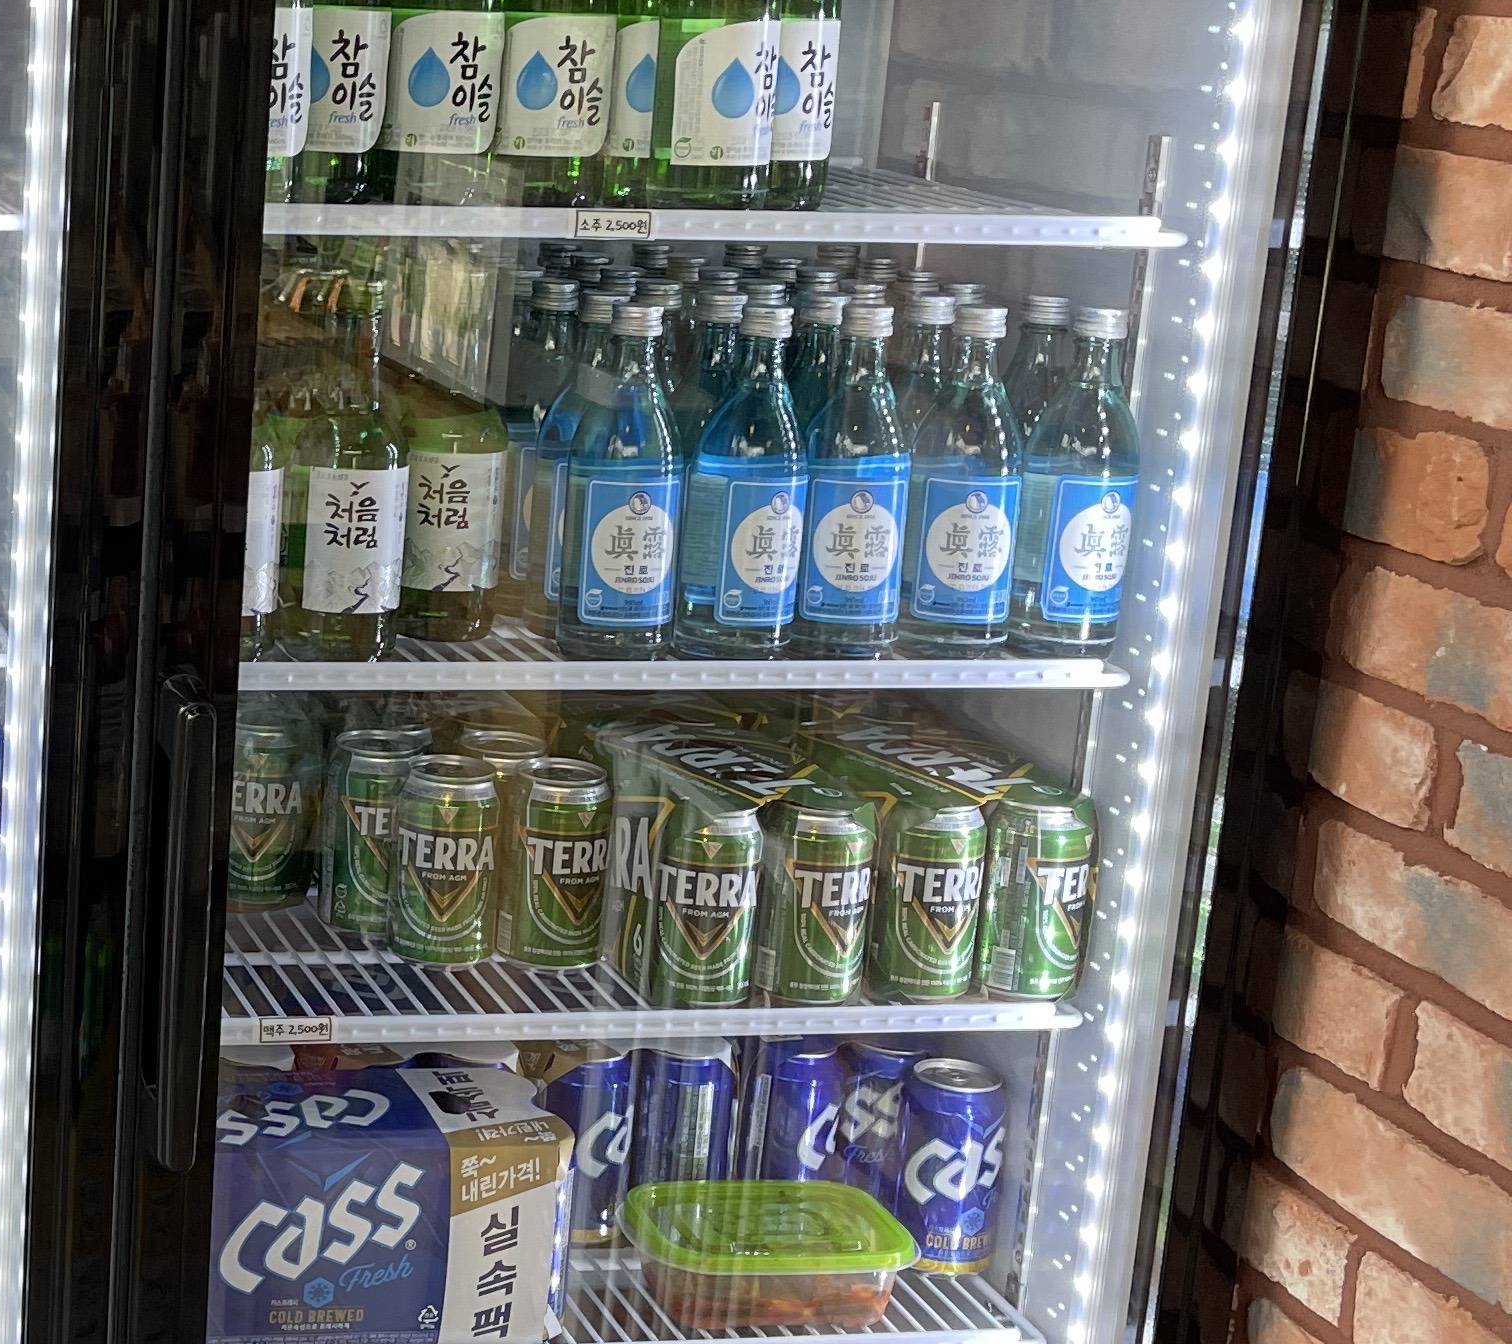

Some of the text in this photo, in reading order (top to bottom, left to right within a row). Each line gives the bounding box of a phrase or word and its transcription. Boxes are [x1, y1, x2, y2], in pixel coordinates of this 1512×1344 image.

[330, 29, 369, 78] 참
[450, 31, 487, 80] 참
[557, 35, 596, 84] 참
[800, 40, 831, 86] 참
[332, 72, 377, 122] 이슬
[452, 74, 494, 123] 이슬
[559, 77, 603, 126] 이슬
[802, 79, 834, 129] 이슬
[328, 110, 357, 125] fresh
[448, 113, 477, 127] fresh
[557, 116, 585, 130] fresh
[579, 218, 648, 234] 소주 2,500원
[325, 492, 381, 523] 처음
[417, 474, 472, 505] 처음
[324, 522, 379, 550] 처럼
[416, 503, 470, 530] 처럼
[398, 825, 495, 871] TERRA
[527, 836, 609, 876] TERR
[421, 870, 468, 883] FROM AGM
[559, 876, 583, 885] FROM
[656, 862, 758, 908] TERRA
[794, 864, 871, 909] TERR
[682, 908, 730, 919] FROM AGM
[930, 905, 954, 913] FROM
[263, 1024, 285, 1037] 맥주
[461, 1156, 540, 1203] 내린가격!
[339, 1253, 413, 1293] Fresh
[470, 1203, 521, 1340] 실속팩
[269, 1308, 365, 1324] COLD BREWED
